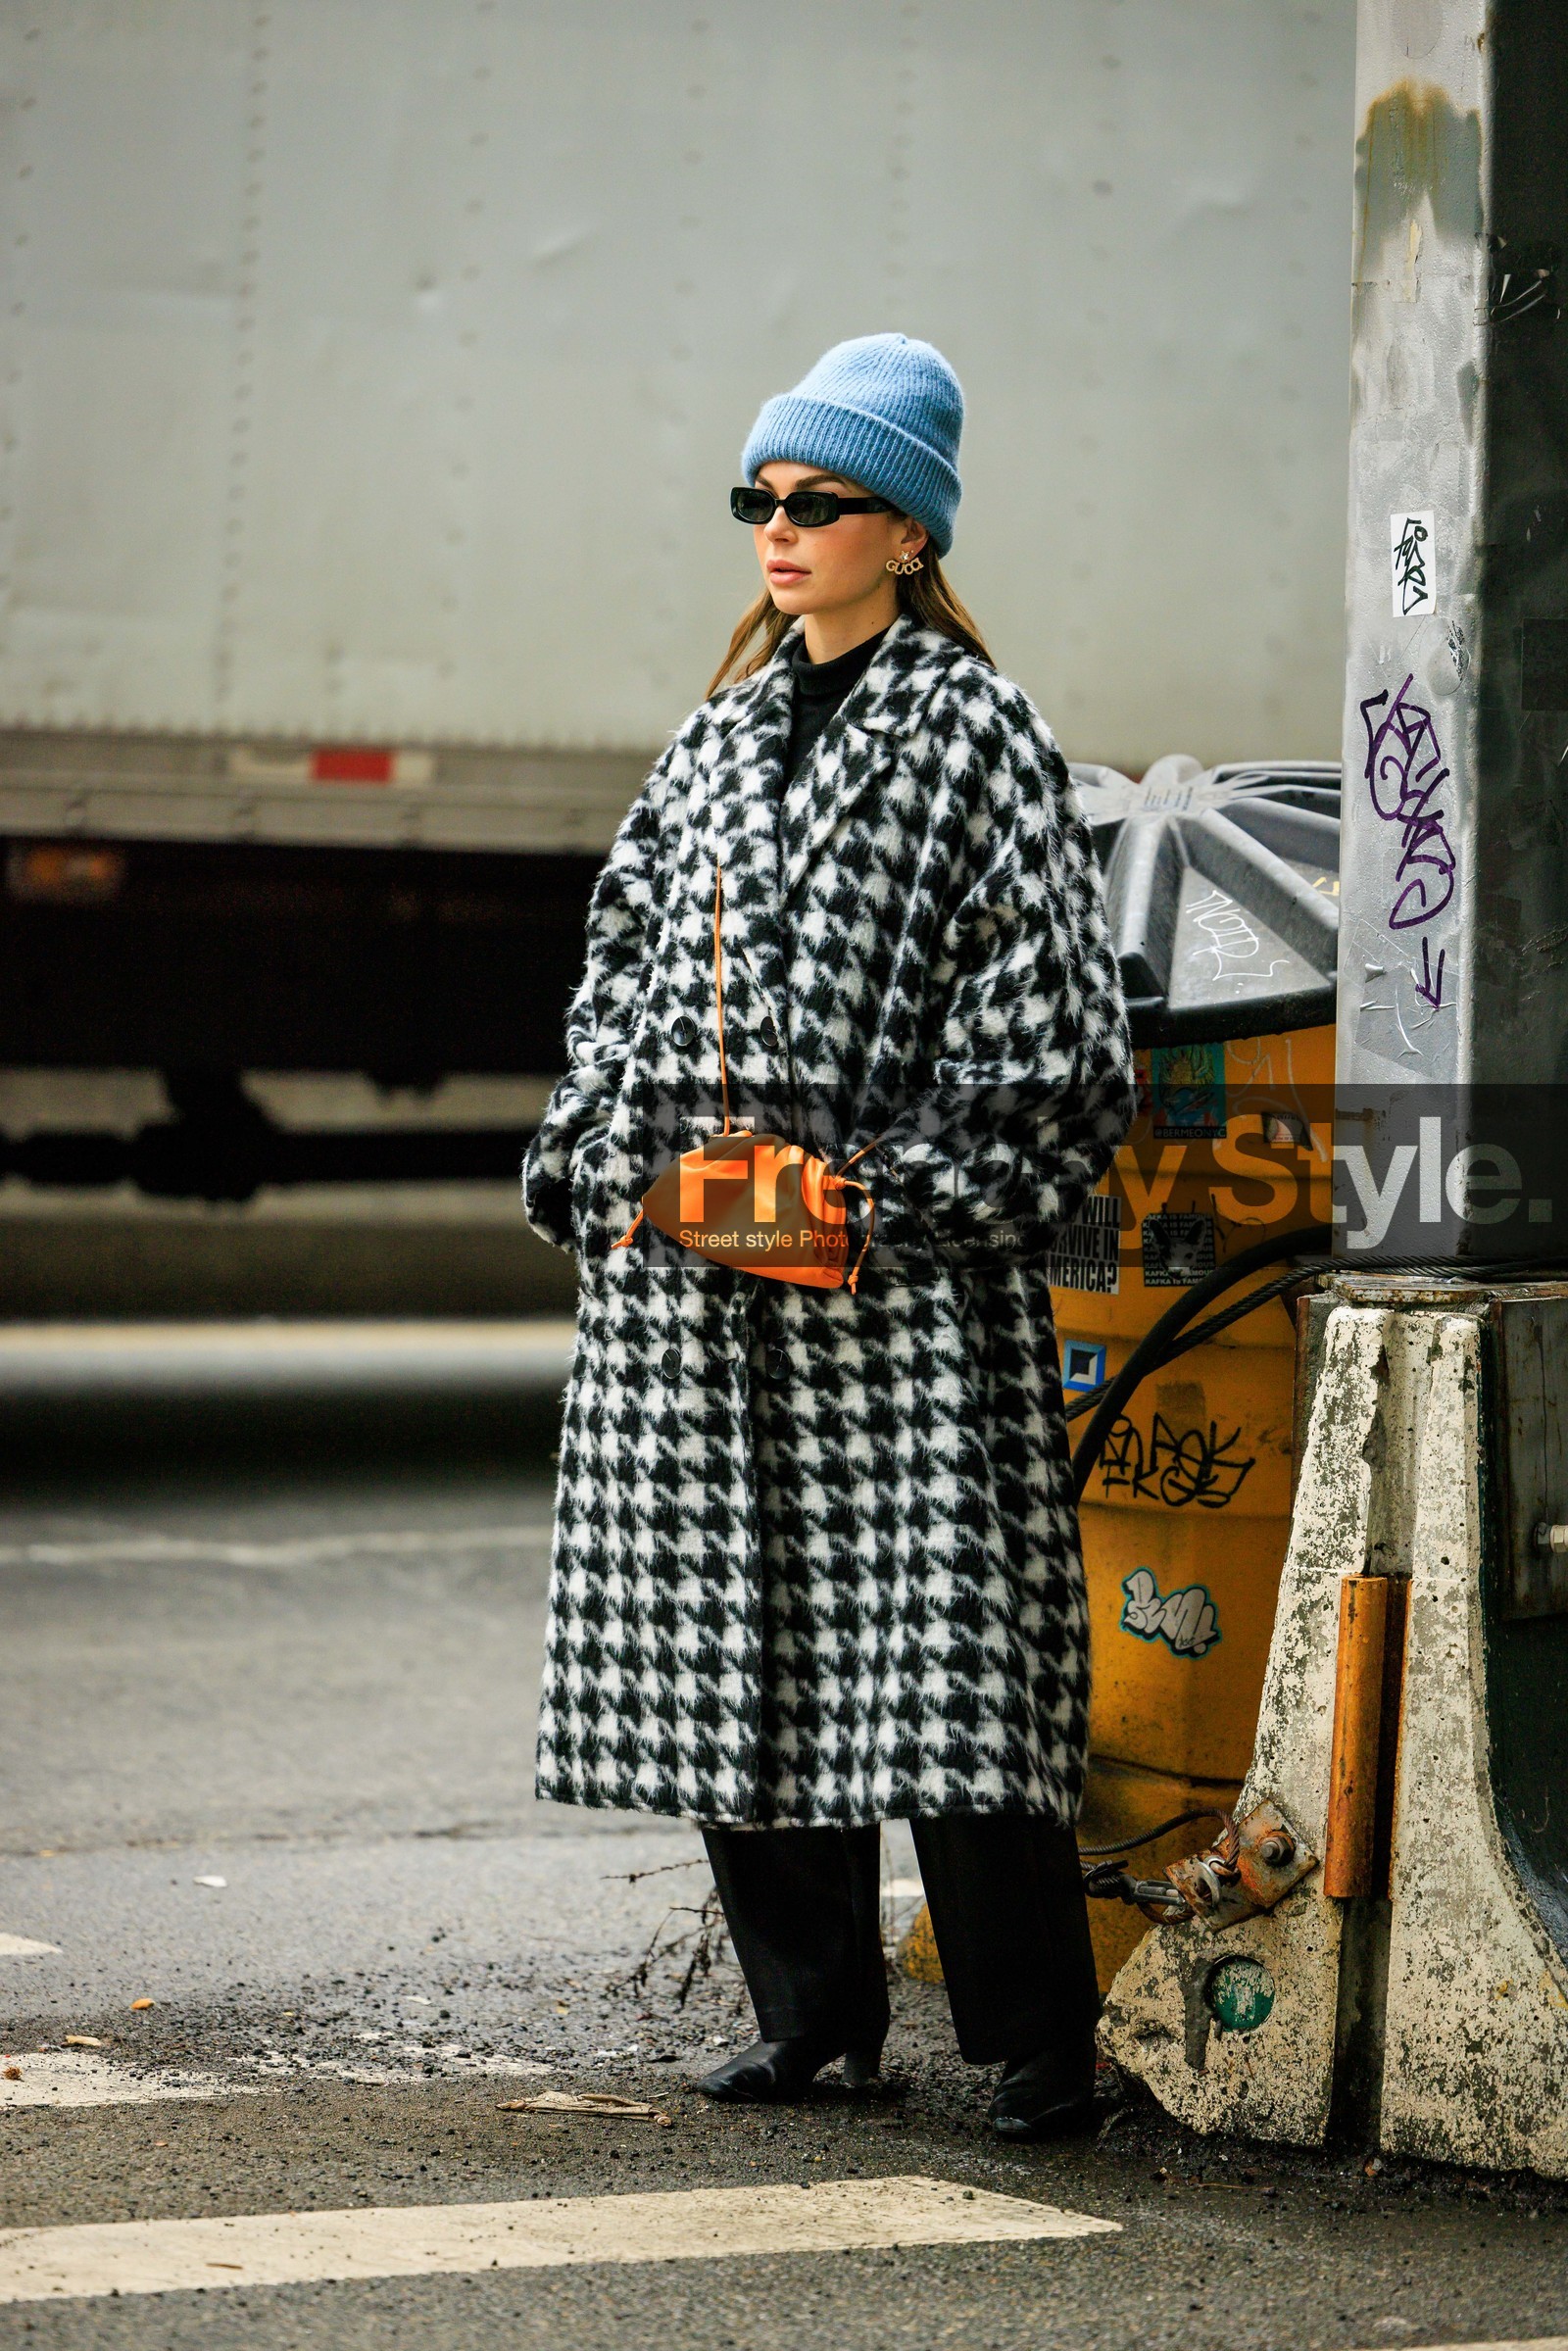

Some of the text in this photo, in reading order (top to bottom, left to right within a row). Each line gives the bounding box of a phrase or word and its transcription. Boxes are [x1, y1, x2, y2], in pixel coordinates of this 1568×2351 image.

[885, 557, 923, 575] GUCCI
[1154, 1128, 1225, 1138] @BERMEONYC
[1103, 1229, 1119, 1261] IN
[1050, 1254, 1117, 1294] MERICA?
